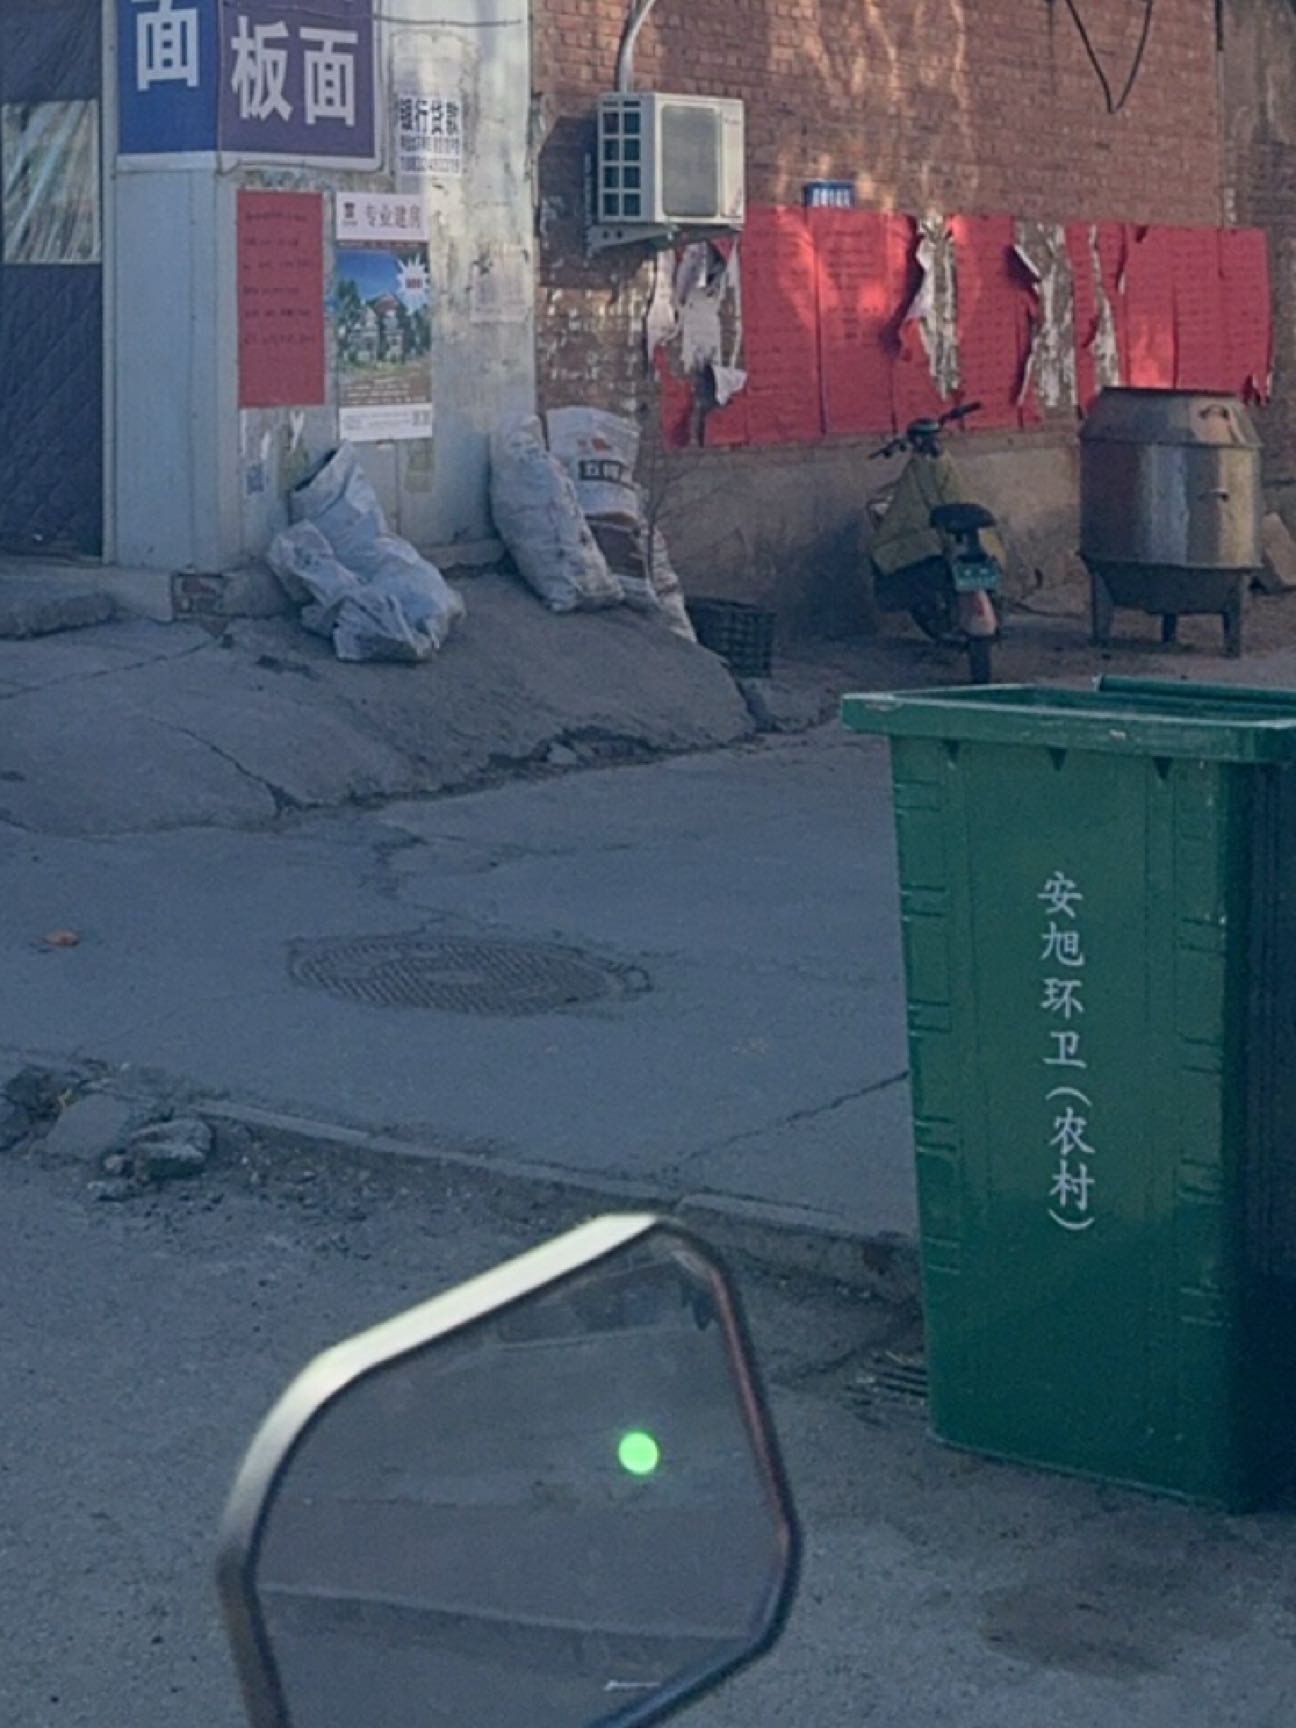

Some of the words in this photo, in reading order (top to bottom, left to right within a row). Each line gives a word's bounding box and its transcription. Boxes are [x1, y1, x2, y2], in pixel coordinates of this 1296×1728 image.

[230, 16, 359, 128] 板面
[1037, 871, 1095, 1231] 安旭环卫（农村）
